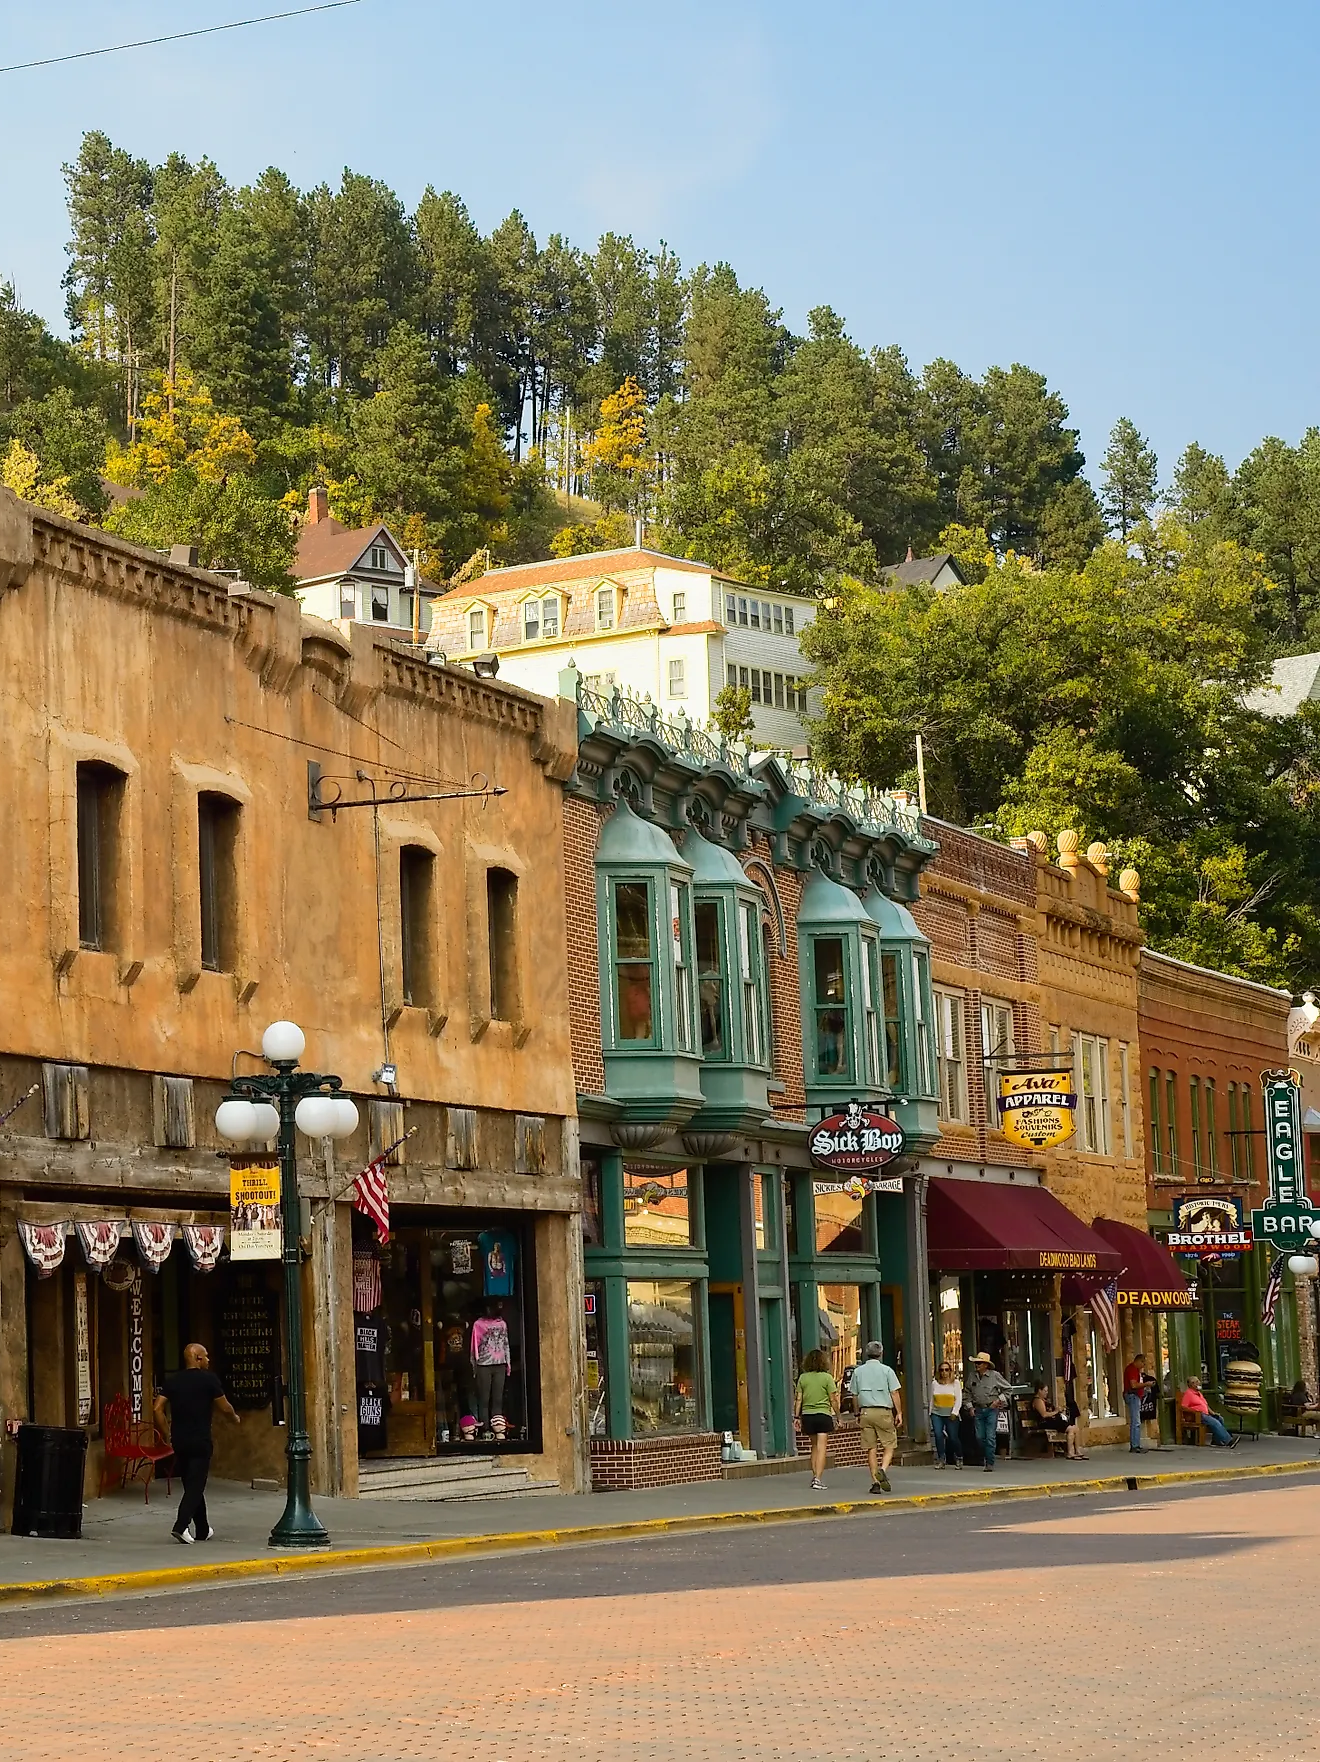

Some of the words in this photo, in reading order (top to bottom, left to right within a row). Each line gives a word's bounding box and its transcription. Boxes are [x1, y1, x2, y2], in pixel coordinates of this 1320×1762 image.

[1012, 1077, 1059, 1090] Ava
[1006, 1094, 1069, 1108] APPAREL
[1013, 1123, 1063, 1132] SOUVENIRS
[811, 1129, 859, 1155] Sick
[860, 1128, 902, 1155] Boy
[1274, 1100, 1295, 1203] EAGLE
[242, 1179, 267, 1187] THRILL
[235, 1190, 276, 1200] SHOOTOUT!
[1263, 1216, 1314, 1233] BAR
[1168, 1232, 1250, 1245] BROTHEL
[1040, 1252, 1069, 1267] DEADWOOD
[1117, 1291, 1190, 1305] DEADWOOD
[1217, 1320, 1240, 1329] STEAK
[1217, 1330, 1241, 1339] HOUSE
[362, 1406, 381, 1416] GUNS
